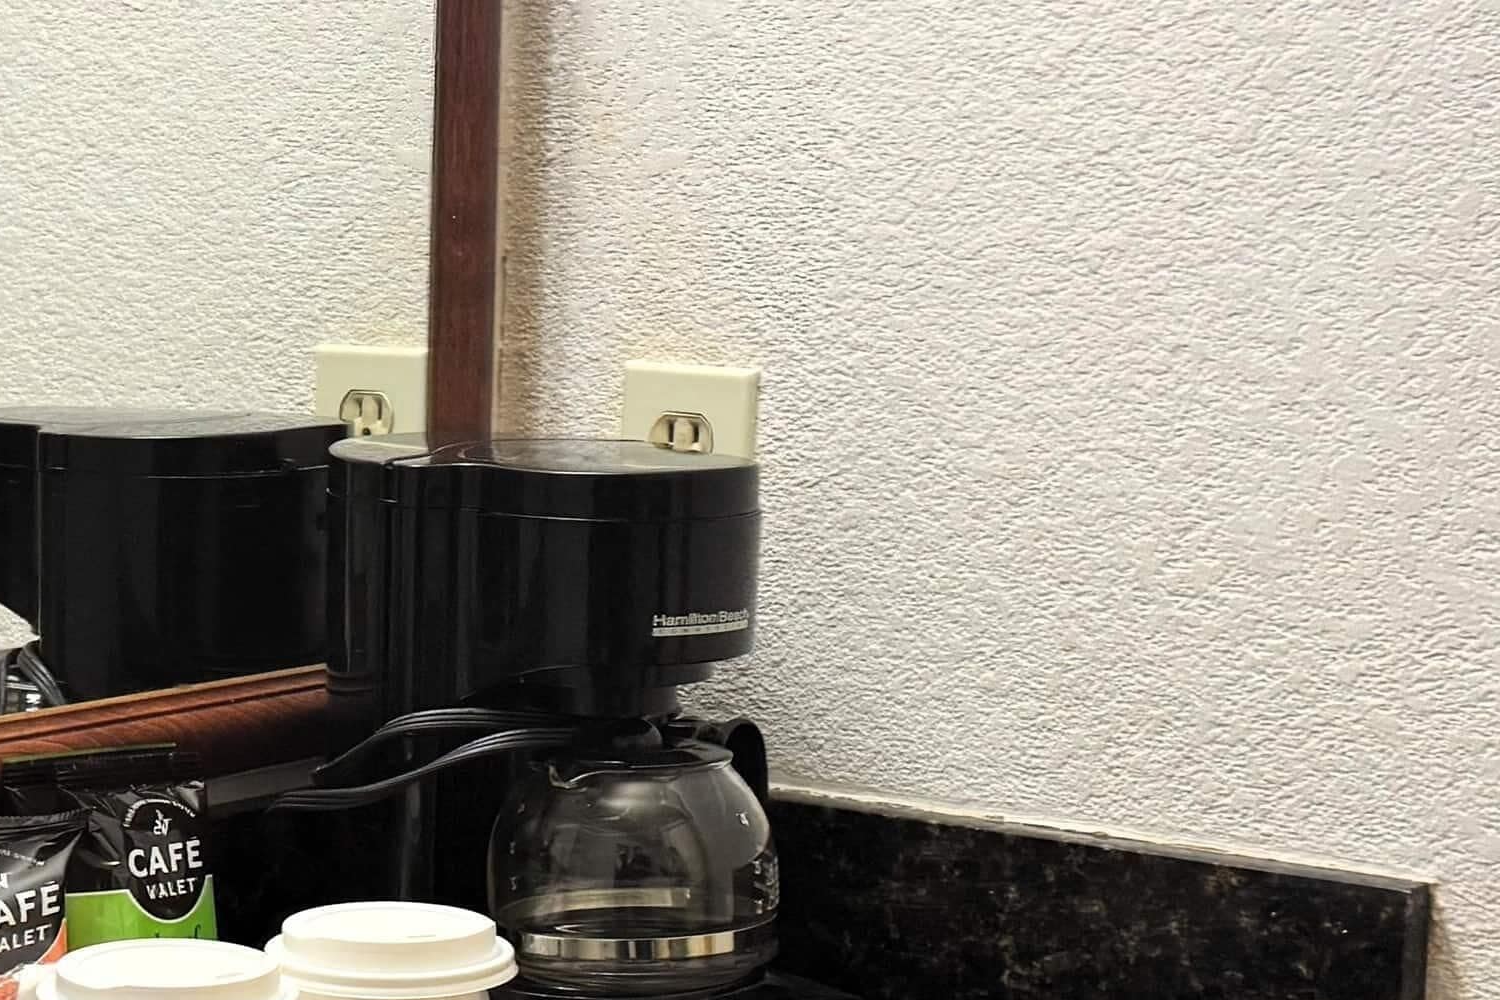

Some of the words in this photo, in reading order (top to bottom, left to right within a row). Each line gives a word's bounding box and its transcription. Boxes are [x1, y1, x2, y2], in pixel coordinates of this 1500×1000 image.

[652, 612, 717, 627] Hamilton
[718, 608, 749, 623] Beach
[127, 836, 203, 878] CAFÉ
[146, 877, 196, 900] VALET
